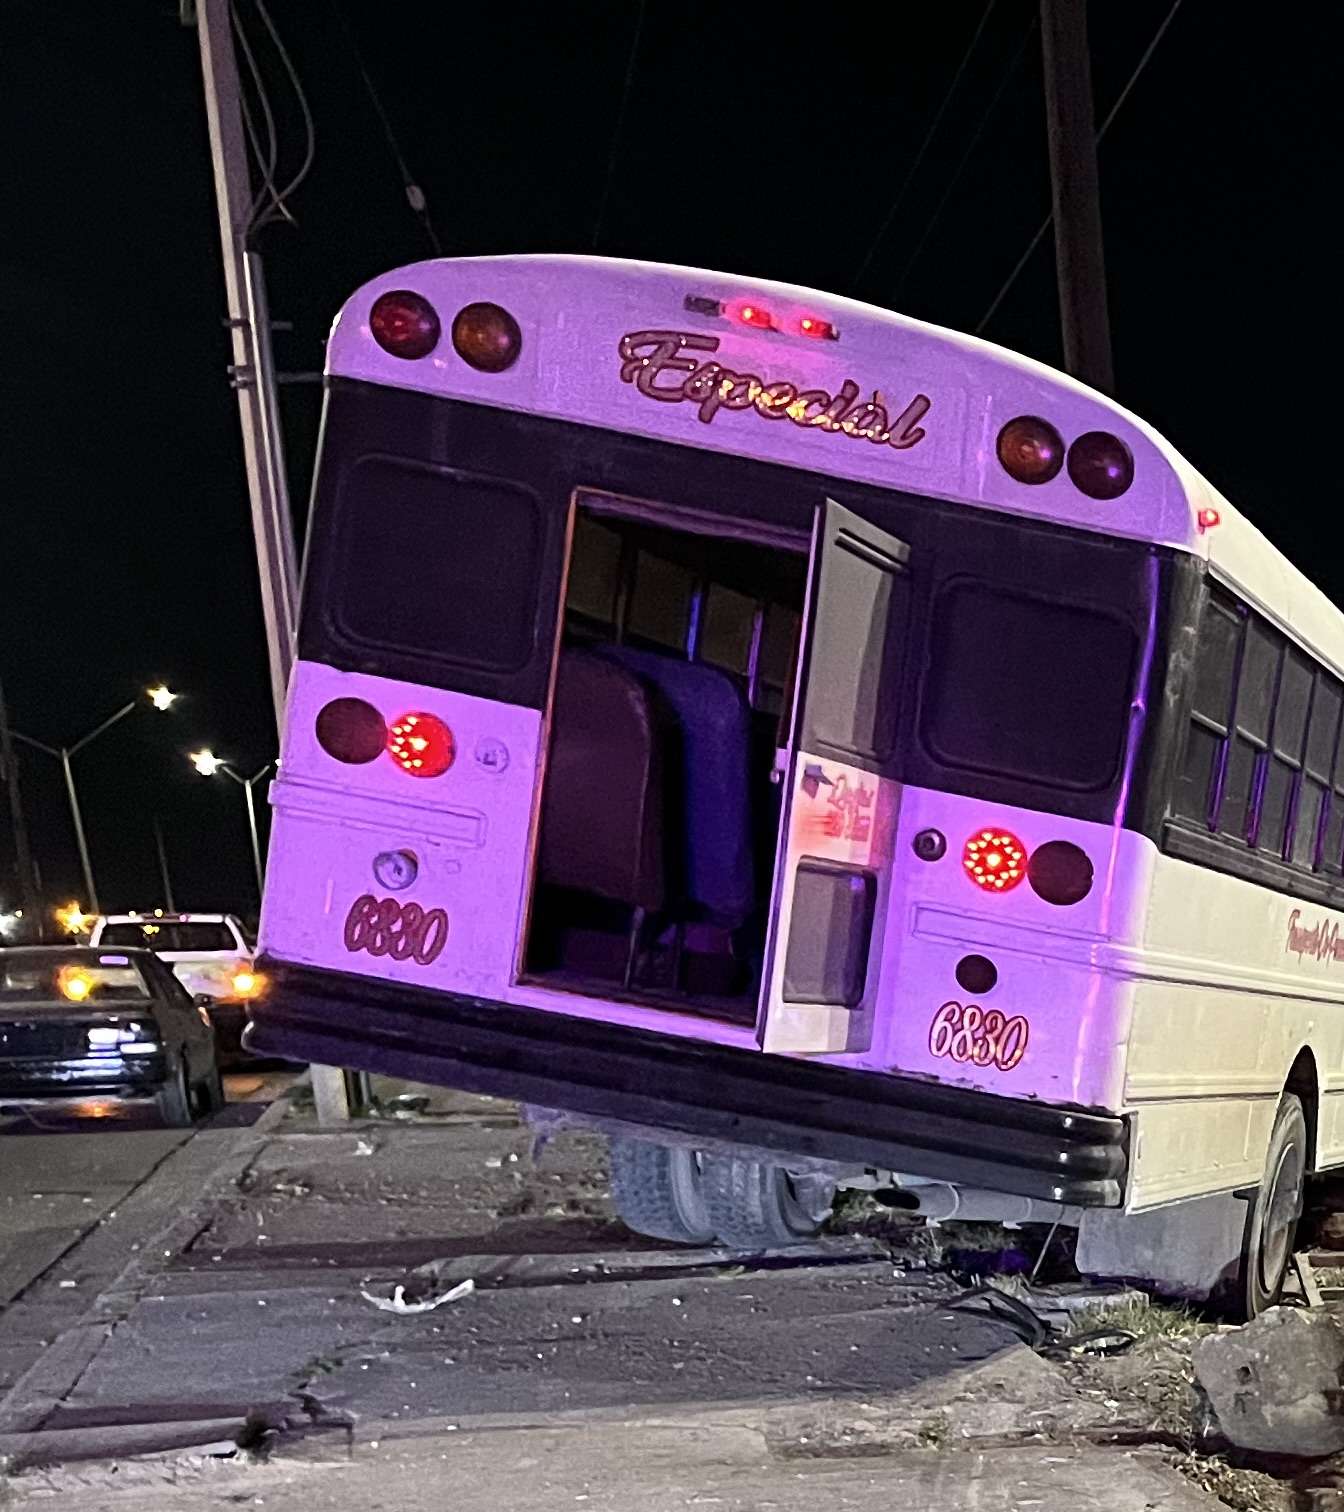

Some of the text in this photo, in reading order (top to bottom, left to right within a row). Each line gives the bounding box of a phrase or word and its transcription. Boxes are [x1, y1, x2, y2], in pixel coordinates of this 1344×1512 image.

[618, 330, 931, 450] Especial
[344, 894, 449, 965] 6830
[928, 1000, 1029, 1071] 6830
